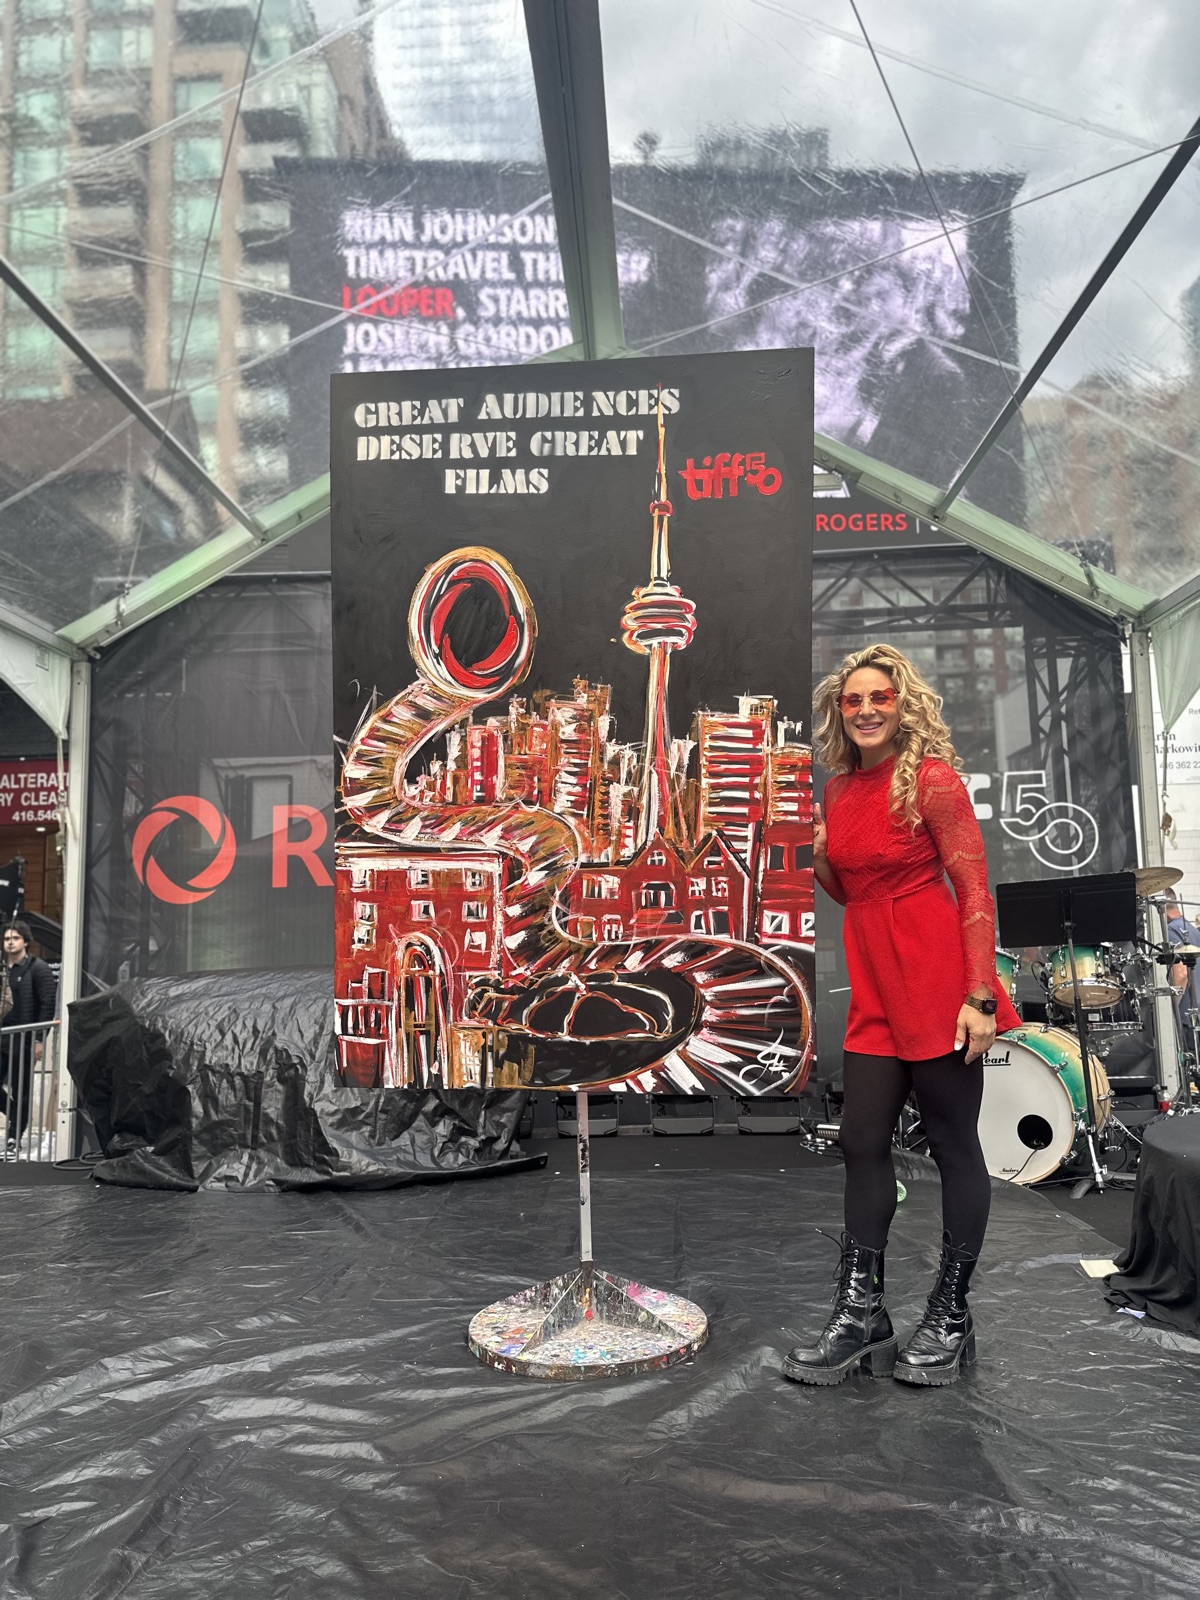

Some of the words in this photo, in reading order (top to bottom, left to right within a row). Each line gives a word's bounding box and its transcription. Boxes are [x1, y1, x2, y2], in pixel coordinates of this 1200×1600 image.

[353, 398, 464, 428] GREAT
[529, 430, 645, 457] GREAT
[444, 468, 550, 495] FILMS
[814, 512, 908, 532] ROGERS
[1175, 760, 1191, 769] 362
